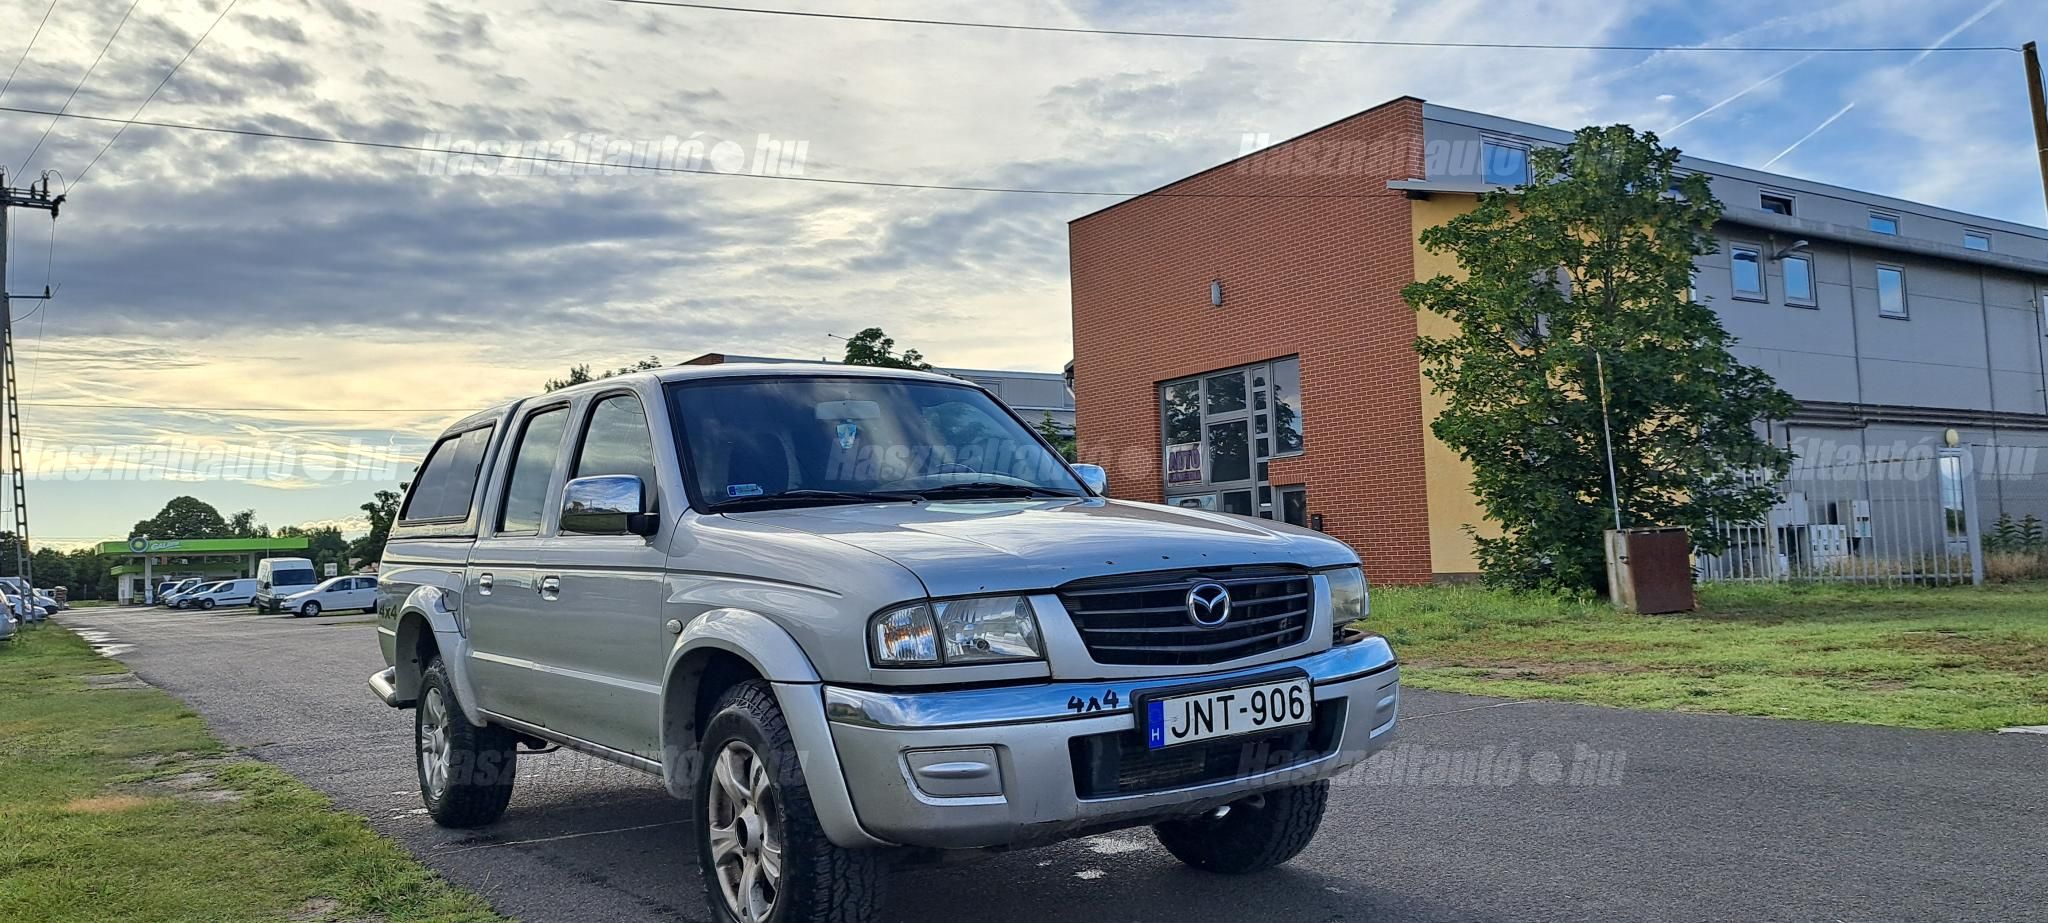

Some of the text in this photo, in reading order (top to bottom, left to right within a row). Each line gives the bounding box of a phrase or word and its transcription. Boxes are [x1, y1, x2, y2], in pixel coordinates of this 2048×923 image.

[379, 603, 398, 620] 4x4
[1151, 685, 1305, 742] H JNT-906
